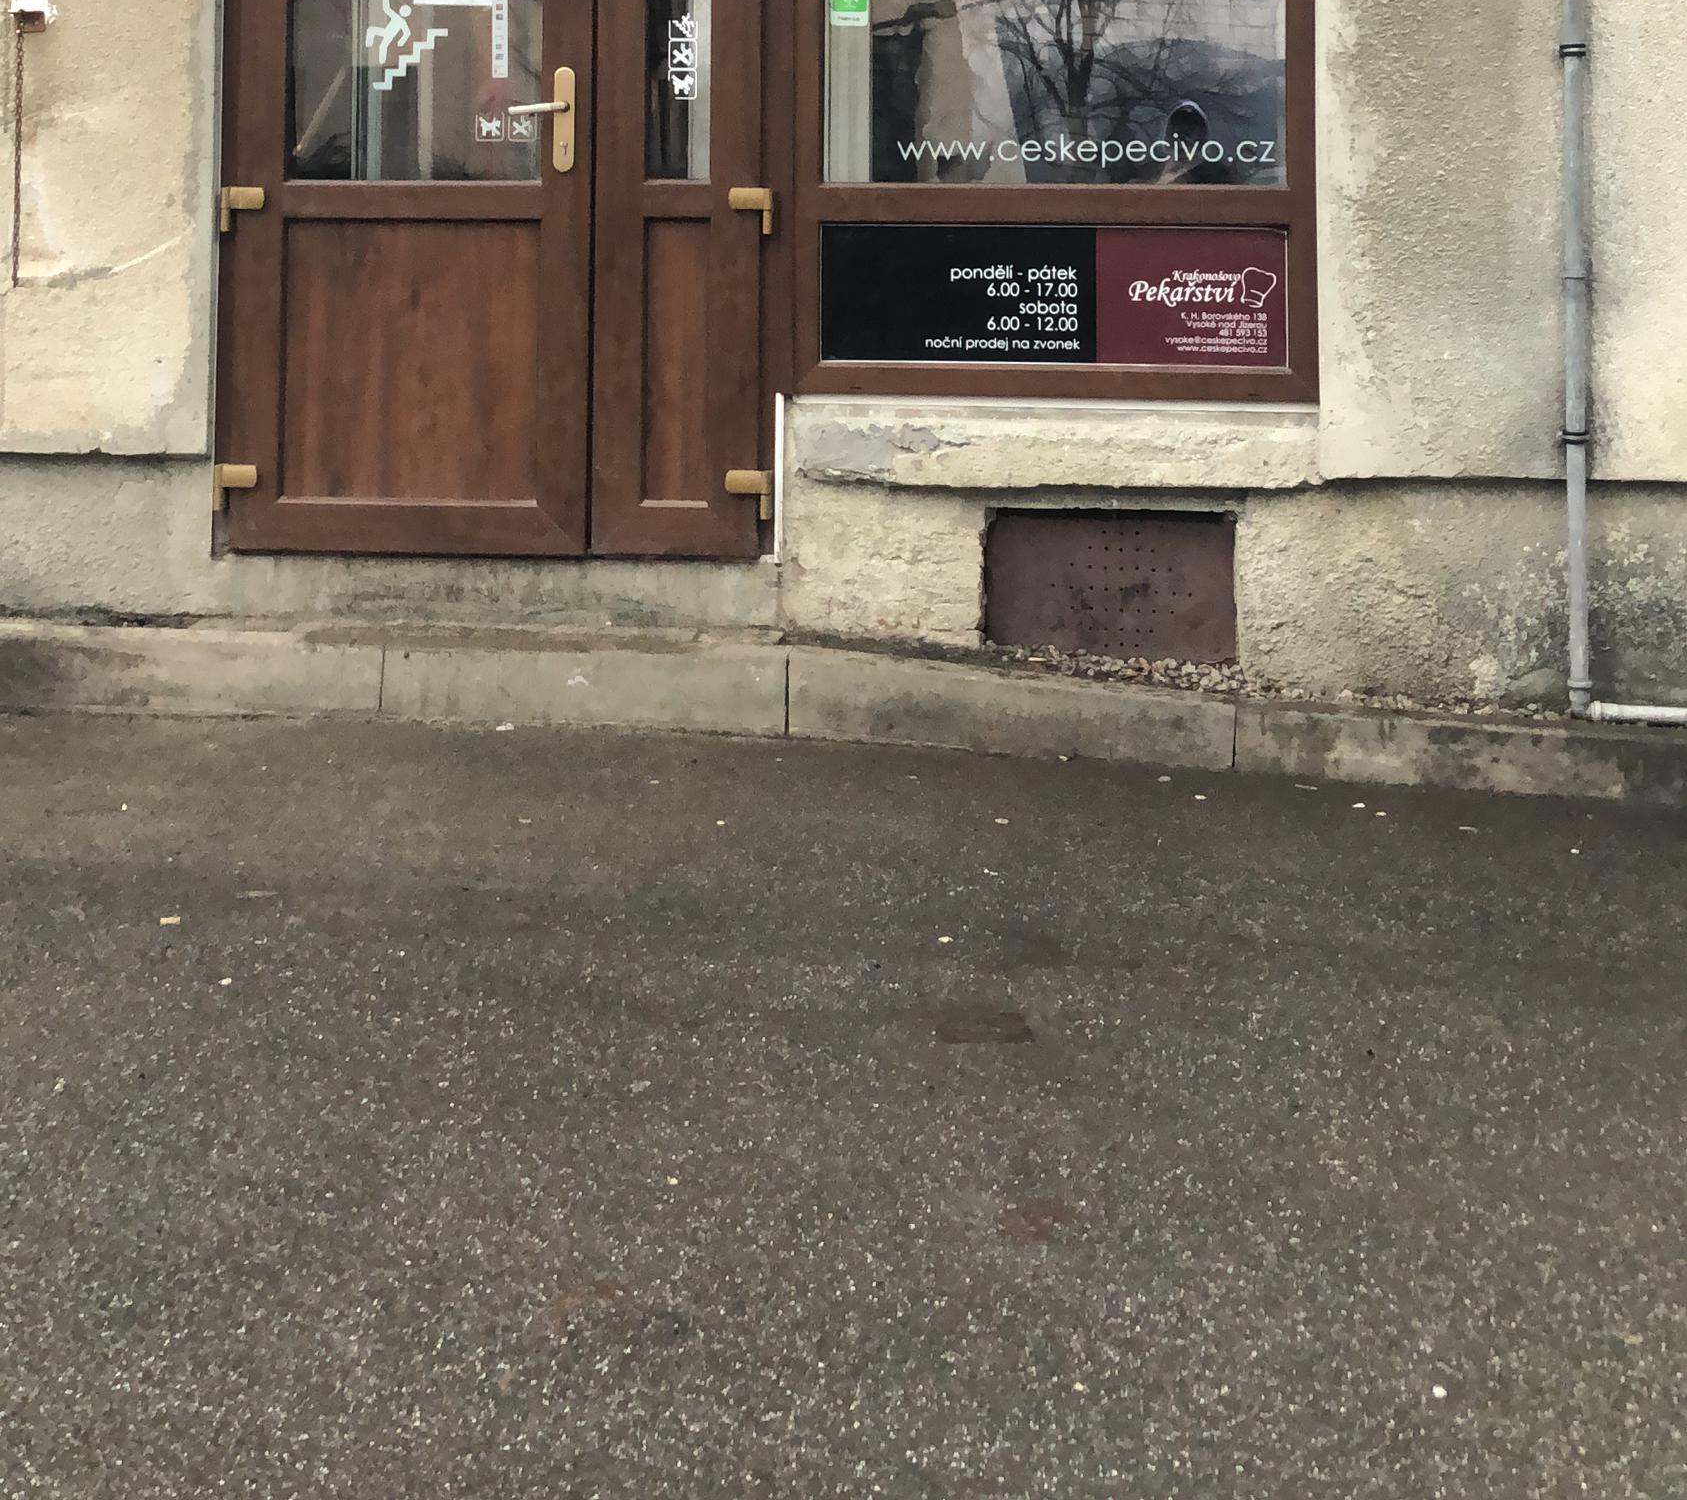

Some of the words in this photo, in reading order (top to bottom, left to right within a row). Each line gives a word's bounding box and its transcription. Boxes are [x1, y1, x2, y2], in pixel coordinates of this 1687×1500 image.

[897, 133, 1276, 169] www.ceskepecivo.cz
[950, 265, 1014, 282] pondělí
[1028, 265, 1078, 282] pátek
[1172, 269, 1241, 283] Krakonošovo
[986, 282, 1020, 297] 6.00
[1037, 282, 1078, 298] 17.00
[1128, 278, 1237, 308] Pekařství
[1019, 300, 1078, 315] sobota
[986, 316, 1020, 331] 6.00
[1037, 316, 1078, 332] 12.00
[1218, 319, 1236, 329] nad
[925, 336, 963, 349] noční
[965, 337, 1009, 352] prodej
[1012, 340, 1030, 349] na
[1033, 338, 1080, 350] zvonek
